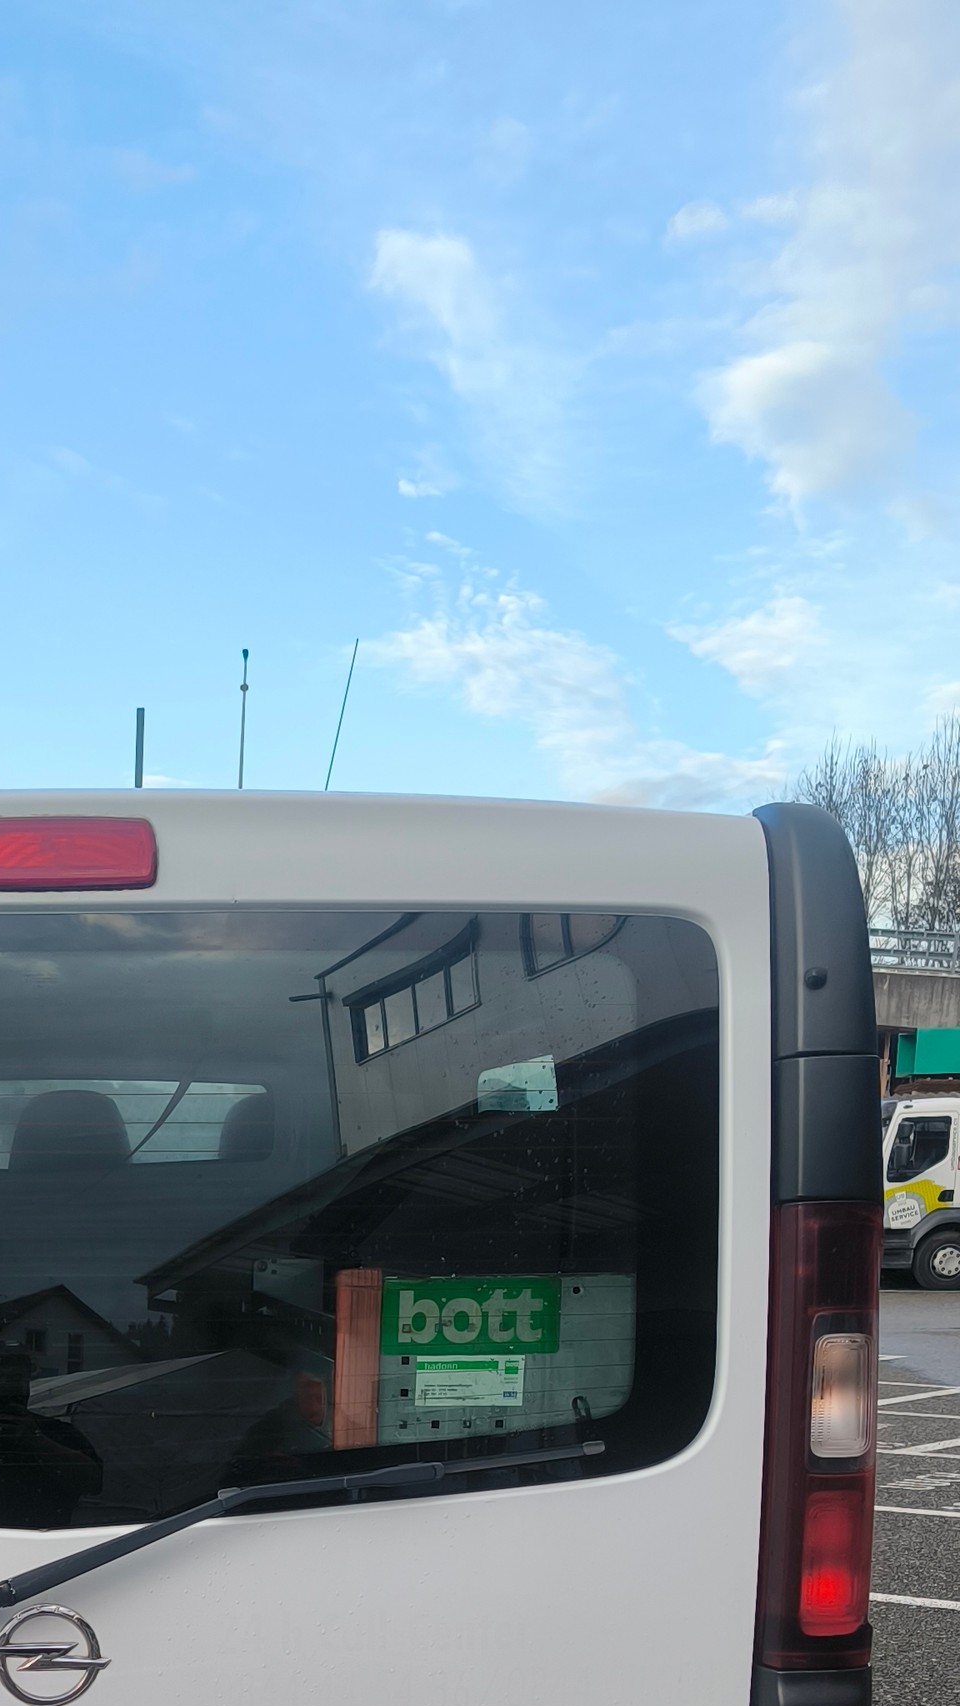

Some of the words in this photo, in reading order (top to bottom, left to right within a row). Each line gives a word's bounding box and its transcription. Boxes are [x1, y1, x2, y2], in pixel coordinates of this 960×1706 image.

[891, 1210, 919, 1222] SERVICE
[892, 1204, 916, 1216] UMBAU
[399, 1288, 544, 1343] bott
